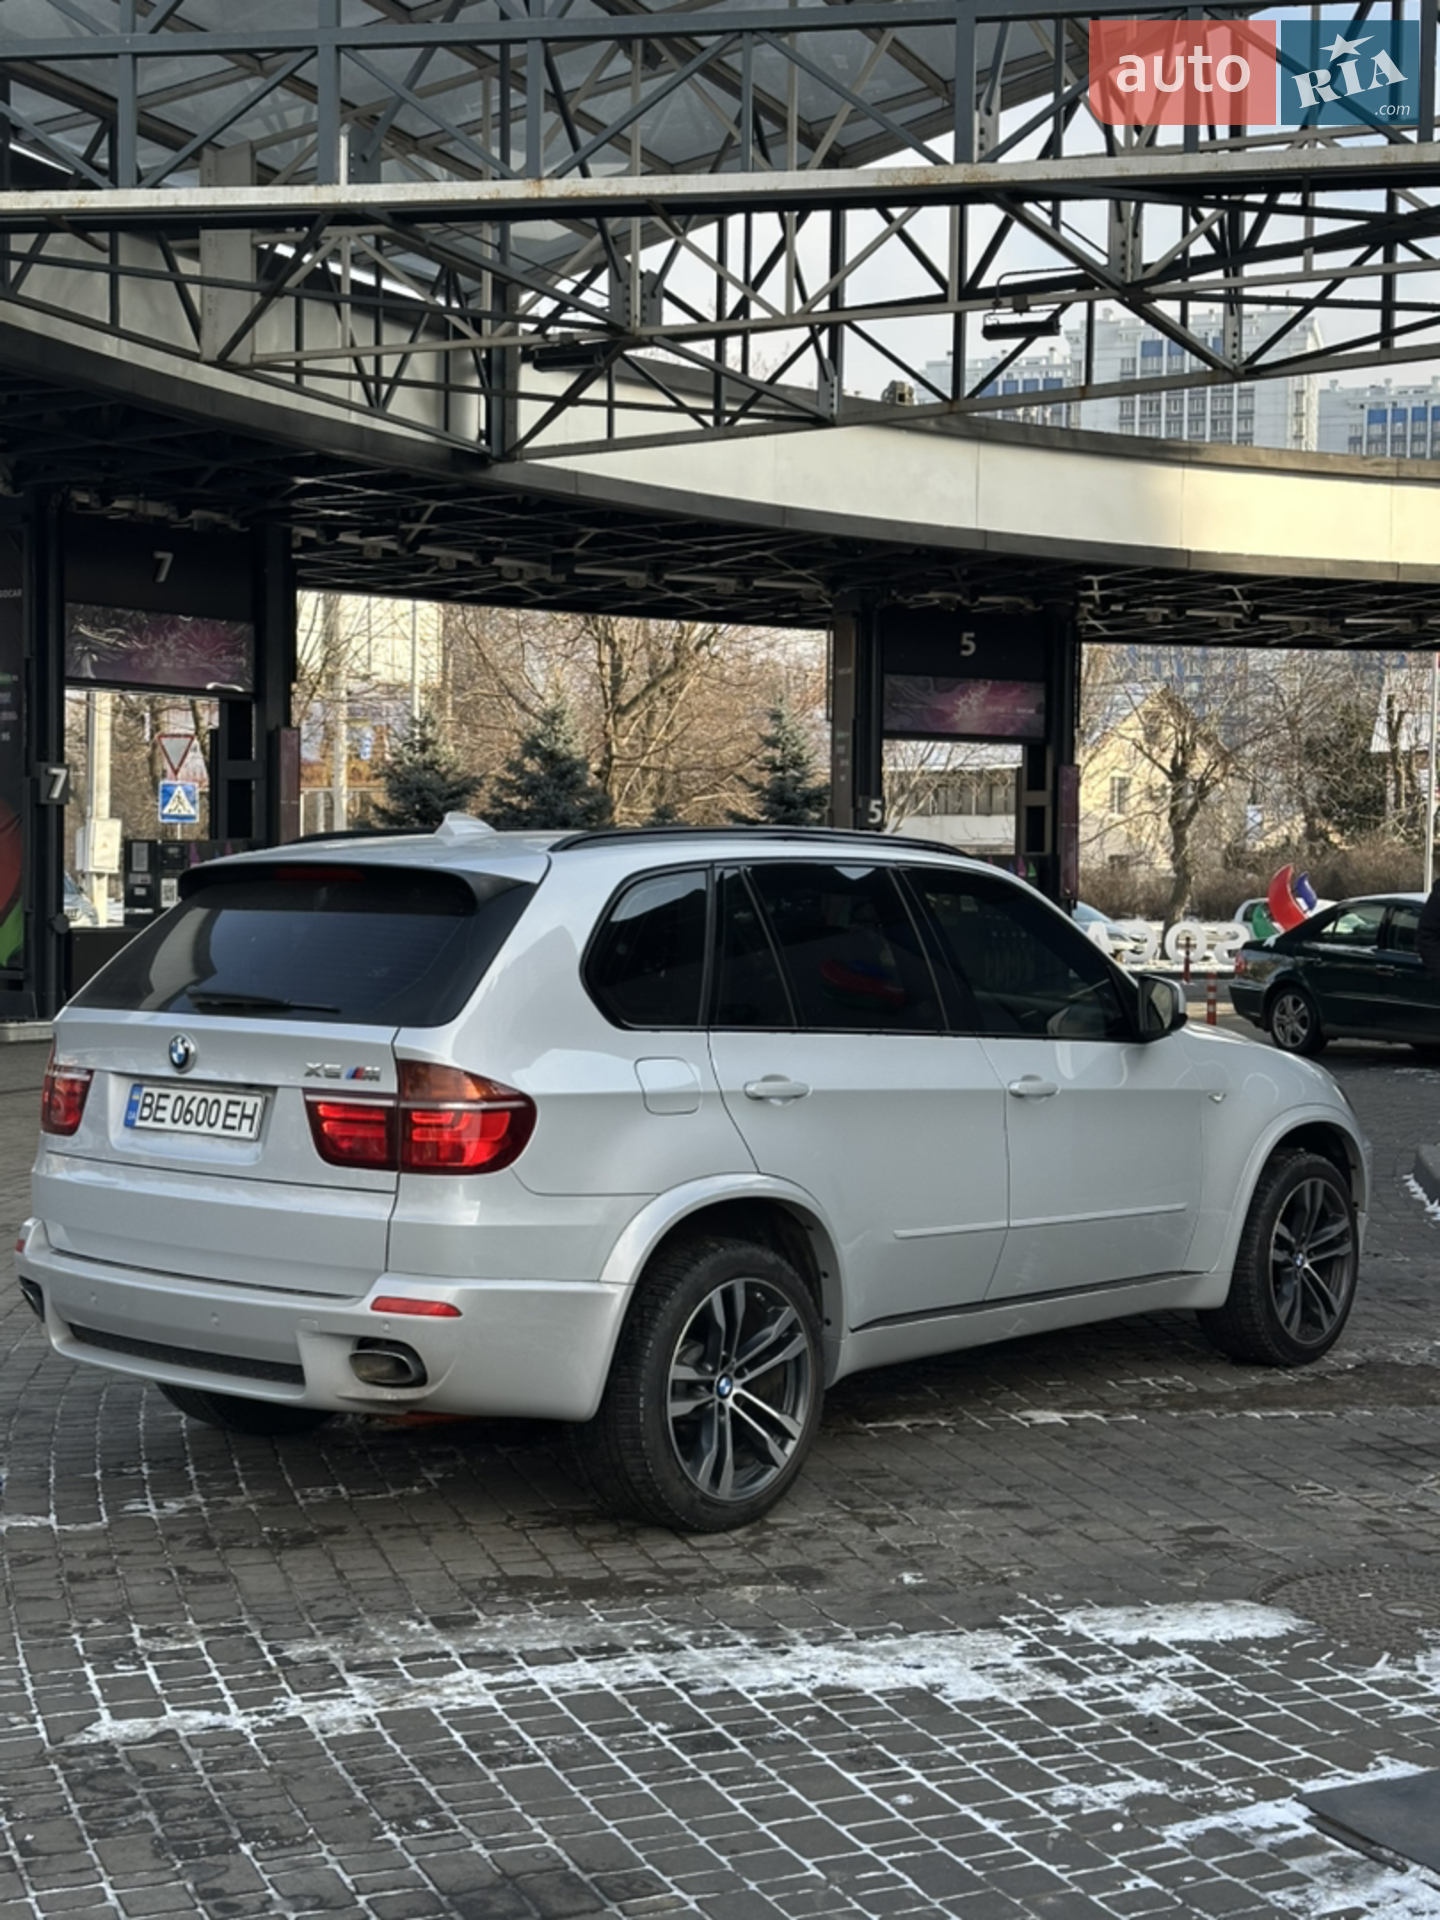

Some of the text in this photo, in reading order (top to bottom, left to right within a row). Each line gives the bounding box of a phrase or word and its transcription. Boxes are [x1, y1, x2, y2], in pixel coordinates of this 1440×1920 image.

[153, 551, 174, 583] 7
[960, 632, 977, 657] 5
[48, 767, 68, 799] 7
[868, 799, 883, 824] 5
[304, 1062, 341, 1079] X5
